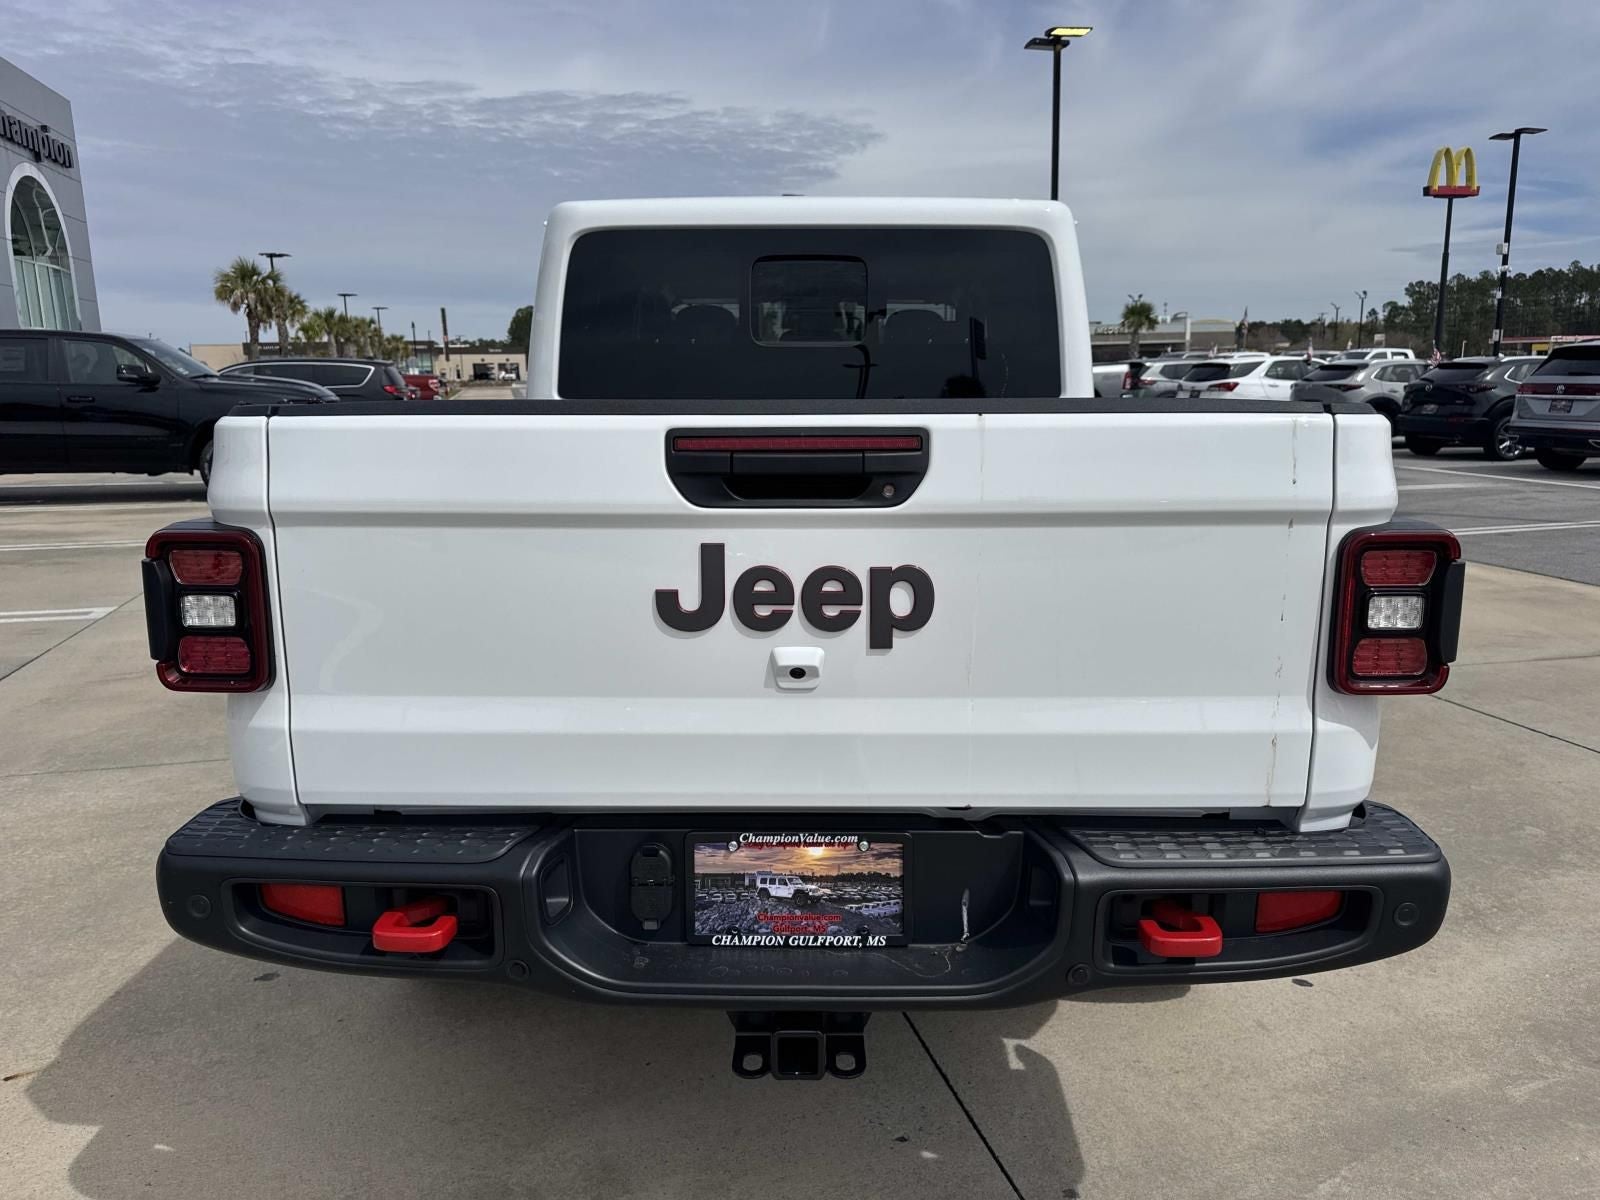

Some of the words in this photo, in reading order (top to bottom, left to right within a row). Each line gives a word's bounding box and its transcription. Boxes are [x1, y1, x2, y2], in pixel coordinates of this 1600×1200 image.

[655, 542, 935, 650] Jeep
[739, 833, 858, 845] ChampionValue.com
[712, 935, 784, 946] CHAMPION
[788, 935, 863, 948] GULFPORT,
[866, 936, 887, 946] MS
